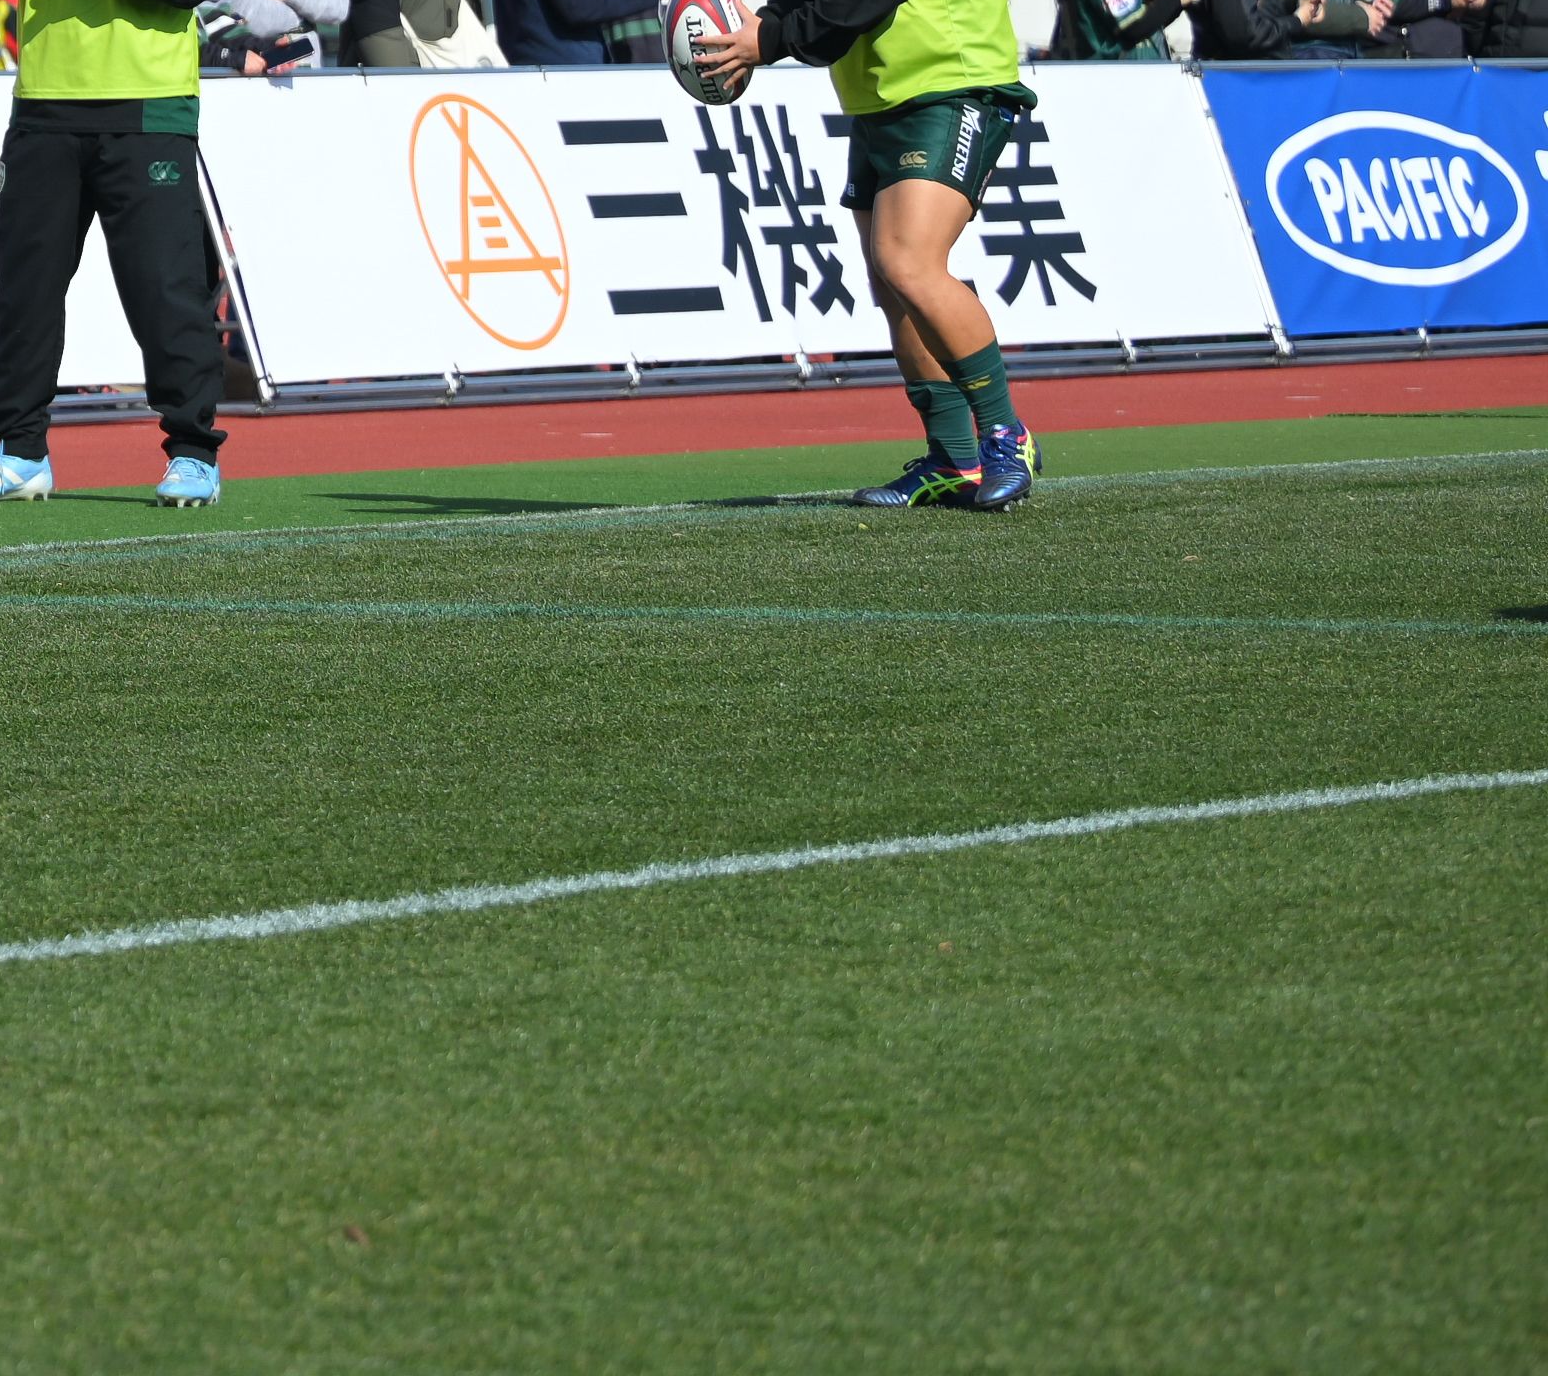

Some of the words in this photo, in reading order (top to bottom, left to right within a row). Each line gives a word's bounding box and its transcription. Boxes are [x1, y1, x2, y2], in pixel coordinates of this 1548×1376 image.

[951, 104, 983, 182] MEITETSU
[558, 105, 1098, 322] 三機業
[1304, 156, 1490, 244] PACIFIC
